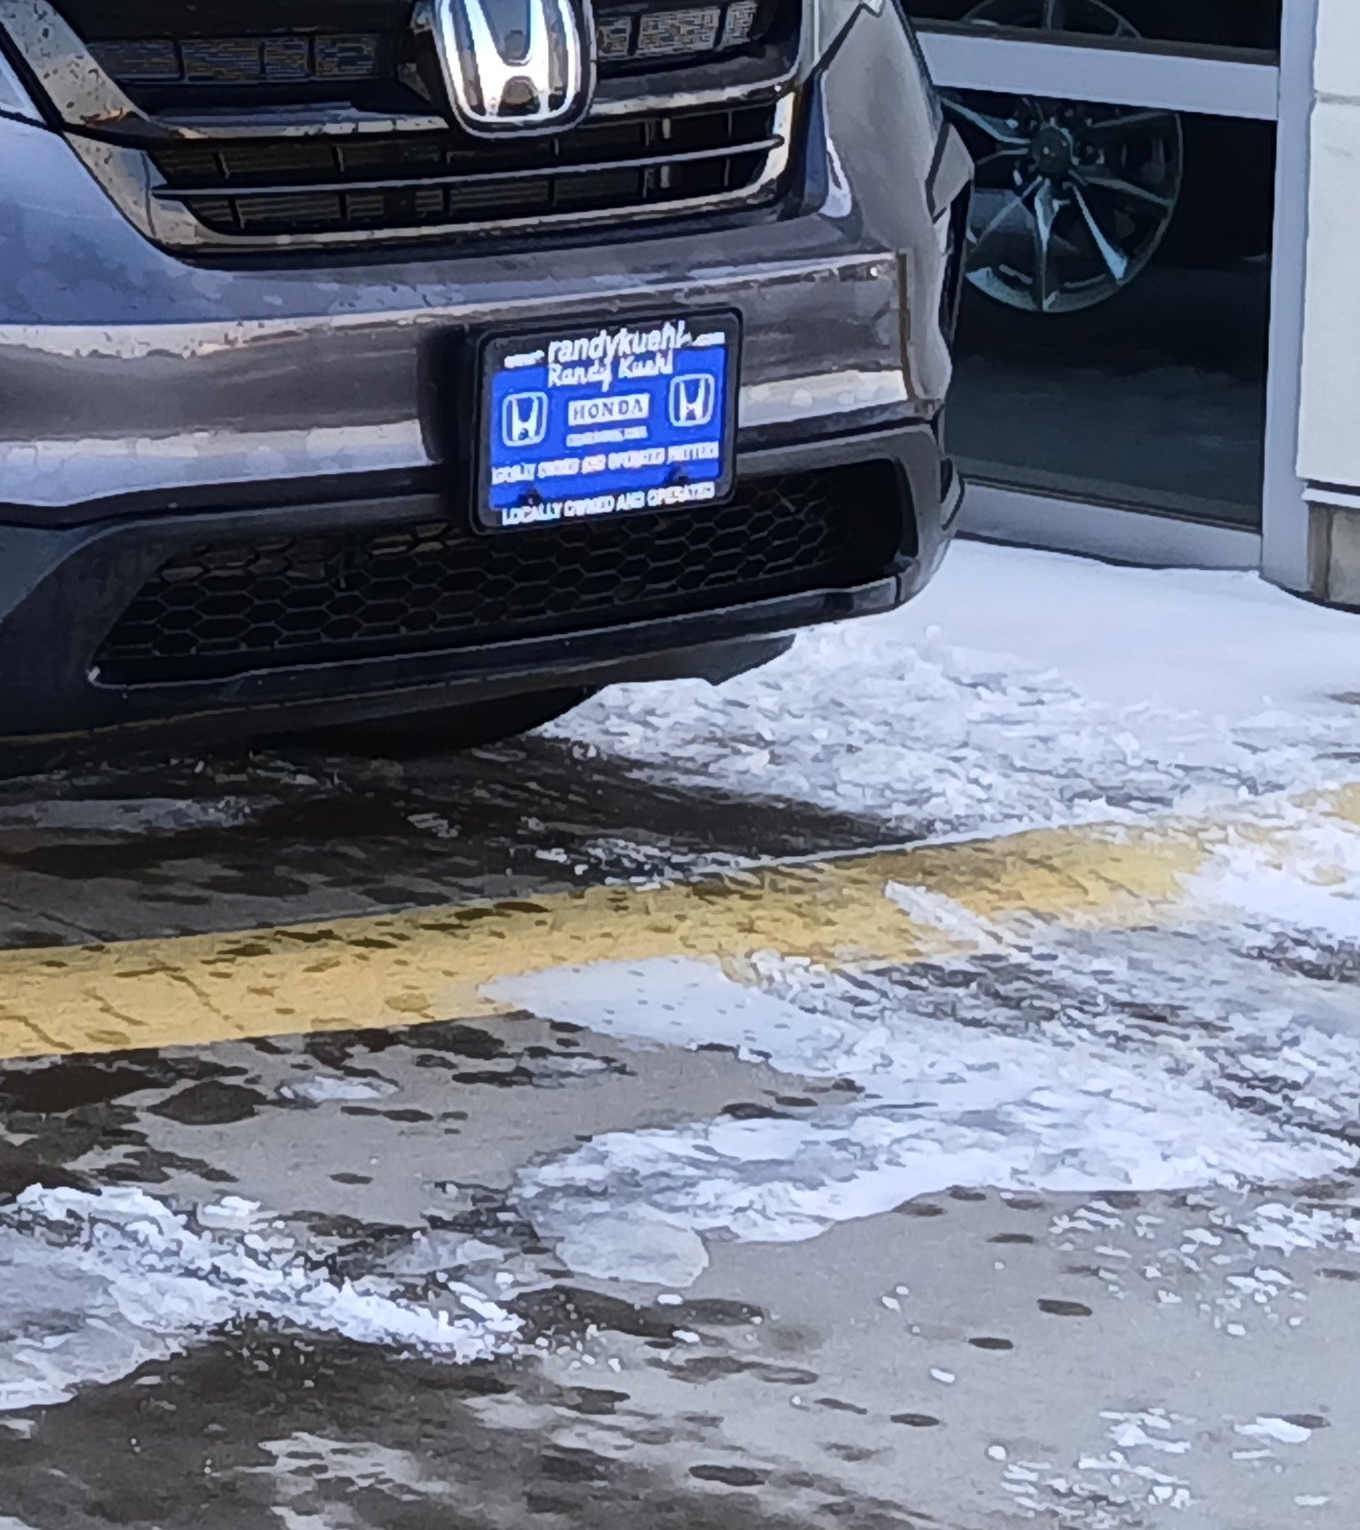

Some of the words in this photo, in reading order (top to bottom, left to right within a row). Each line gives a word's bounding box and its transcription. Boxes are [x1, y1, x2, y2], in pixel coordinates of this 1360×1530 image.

[548, 359, 612, 392] Randy
[573, 398, 643, 421] HONDA
[502, 502, 562, 526] LOCALLY
[564, 495, 615, 517] OWNED
[616, 490, 645, 512] AND
